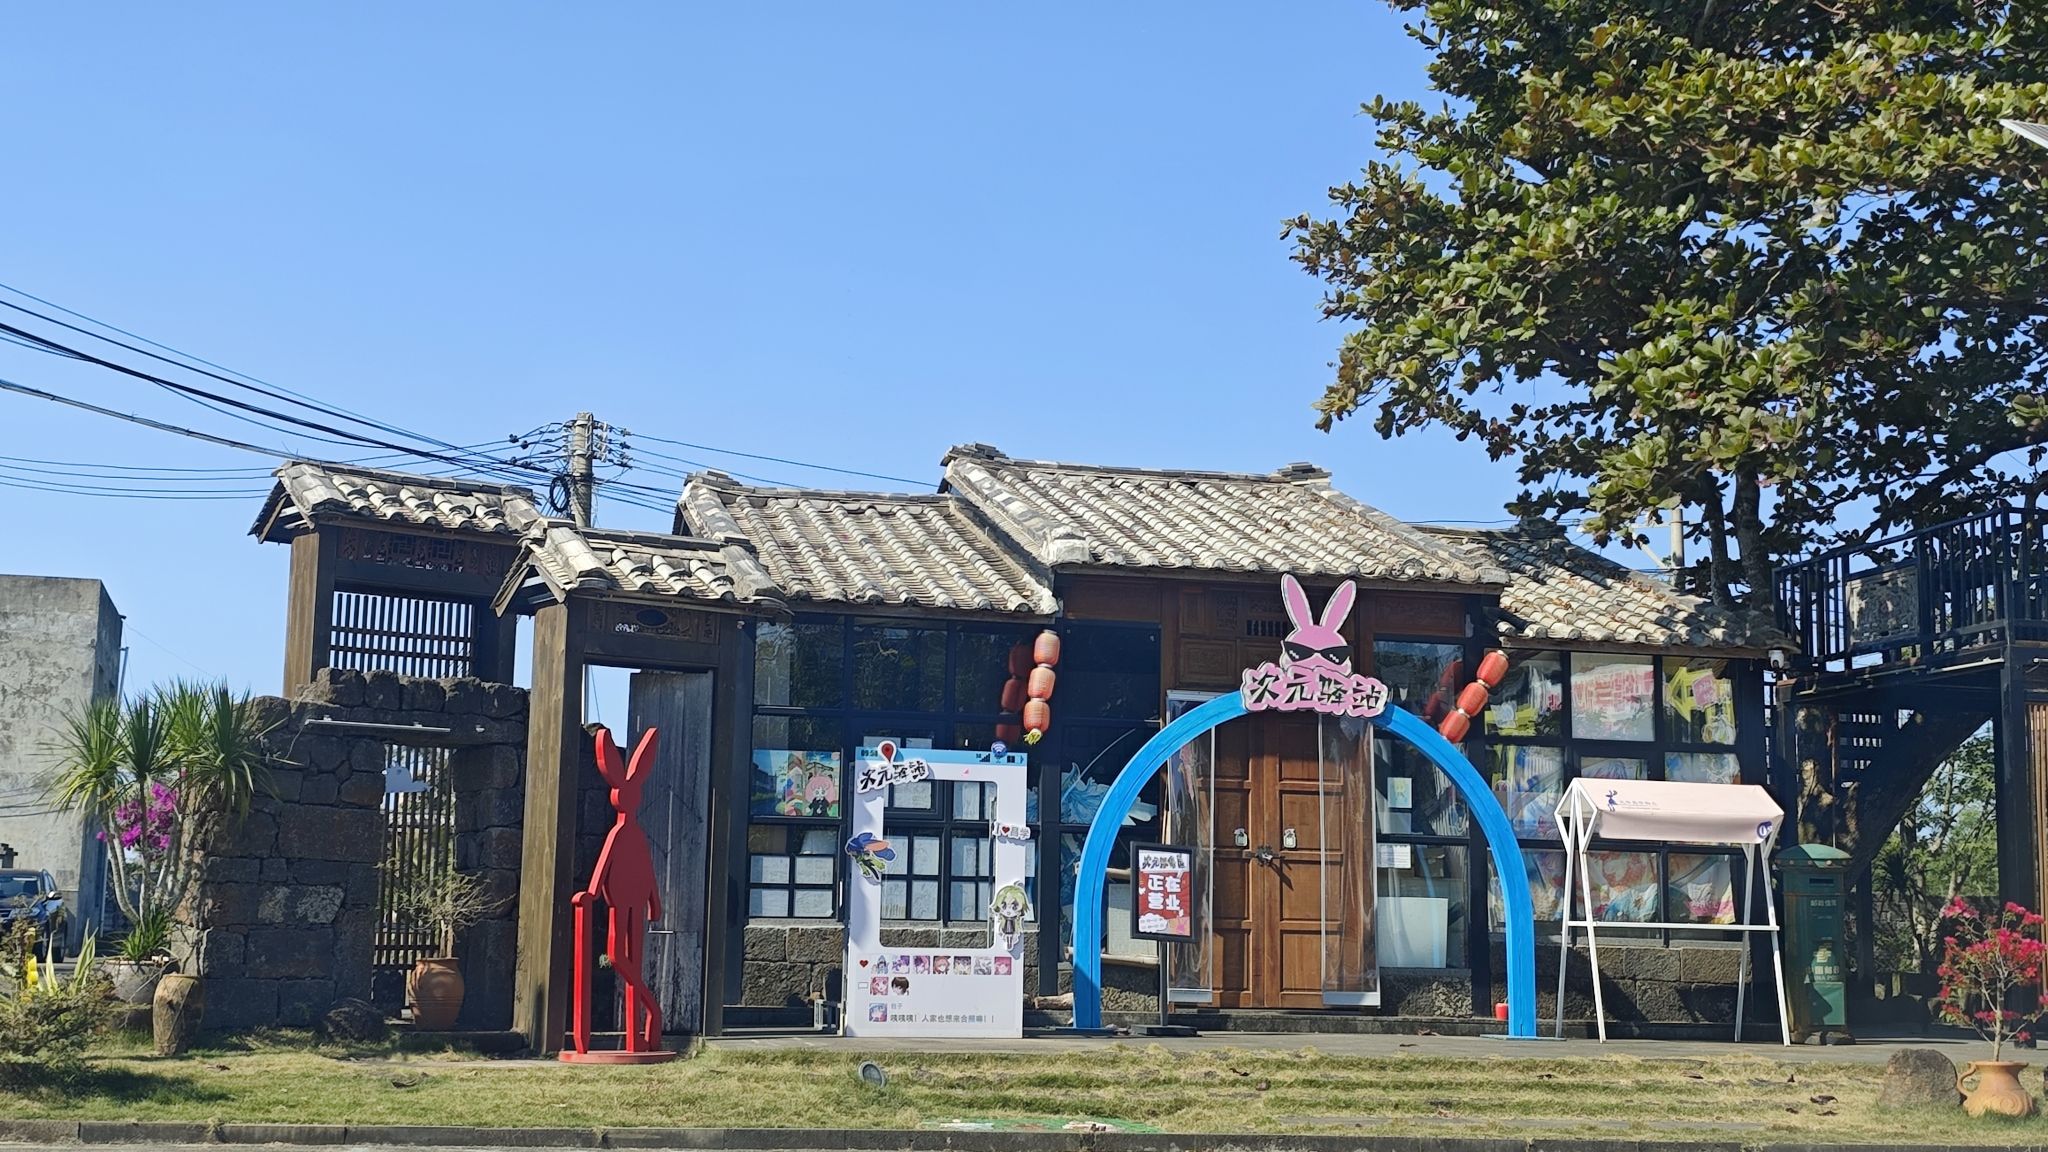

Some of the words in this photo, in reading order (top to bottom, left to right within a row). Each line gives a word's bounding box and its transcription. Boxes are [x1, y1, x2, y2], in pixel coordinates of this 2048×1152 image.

[1249, 672, 1382, 710] 次元驿站
[1148, 874, 1181, 892] 正在
[1148, 892, 1180, 910] 营业
